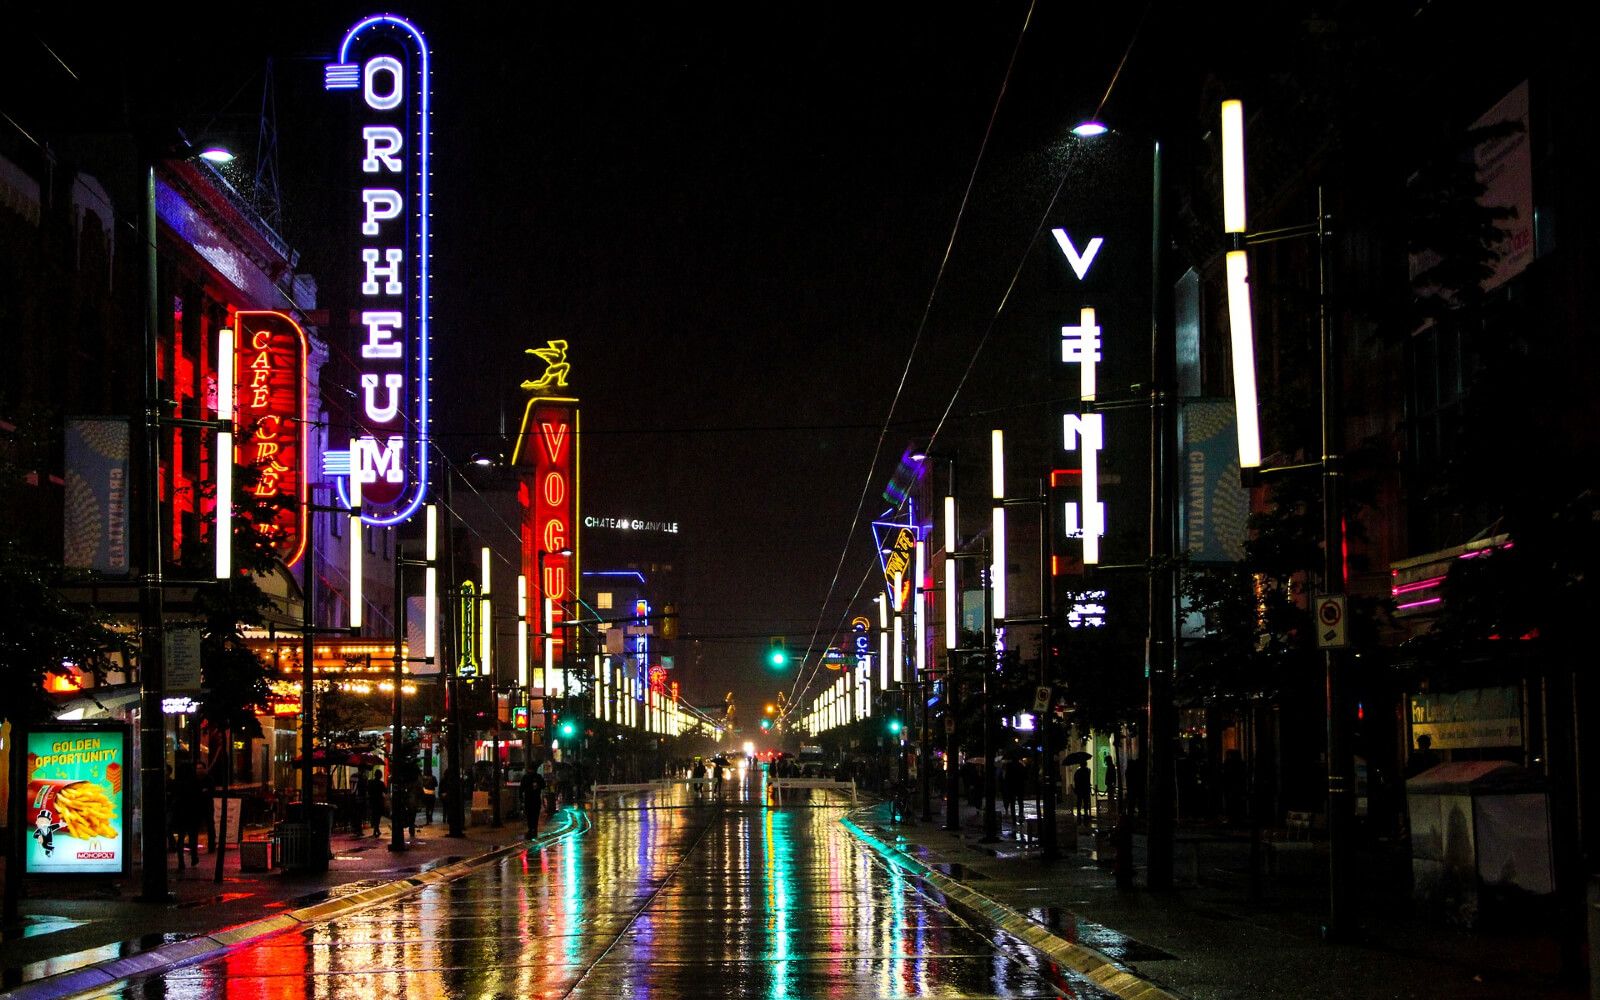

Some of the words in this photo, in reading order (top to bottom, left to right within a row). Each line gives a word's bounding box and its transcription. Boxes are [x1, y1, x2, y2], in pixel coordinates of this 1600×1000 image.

[360, 56, 404, 484] ORPHEUM
[631, 519, 679, 533] GRANVILLE
[52, 738, 101, 753] GOLDEN
[35, 748, 118, 768] OPPORTUNITY
[77, 851, 114, 859] MONOPOLY
